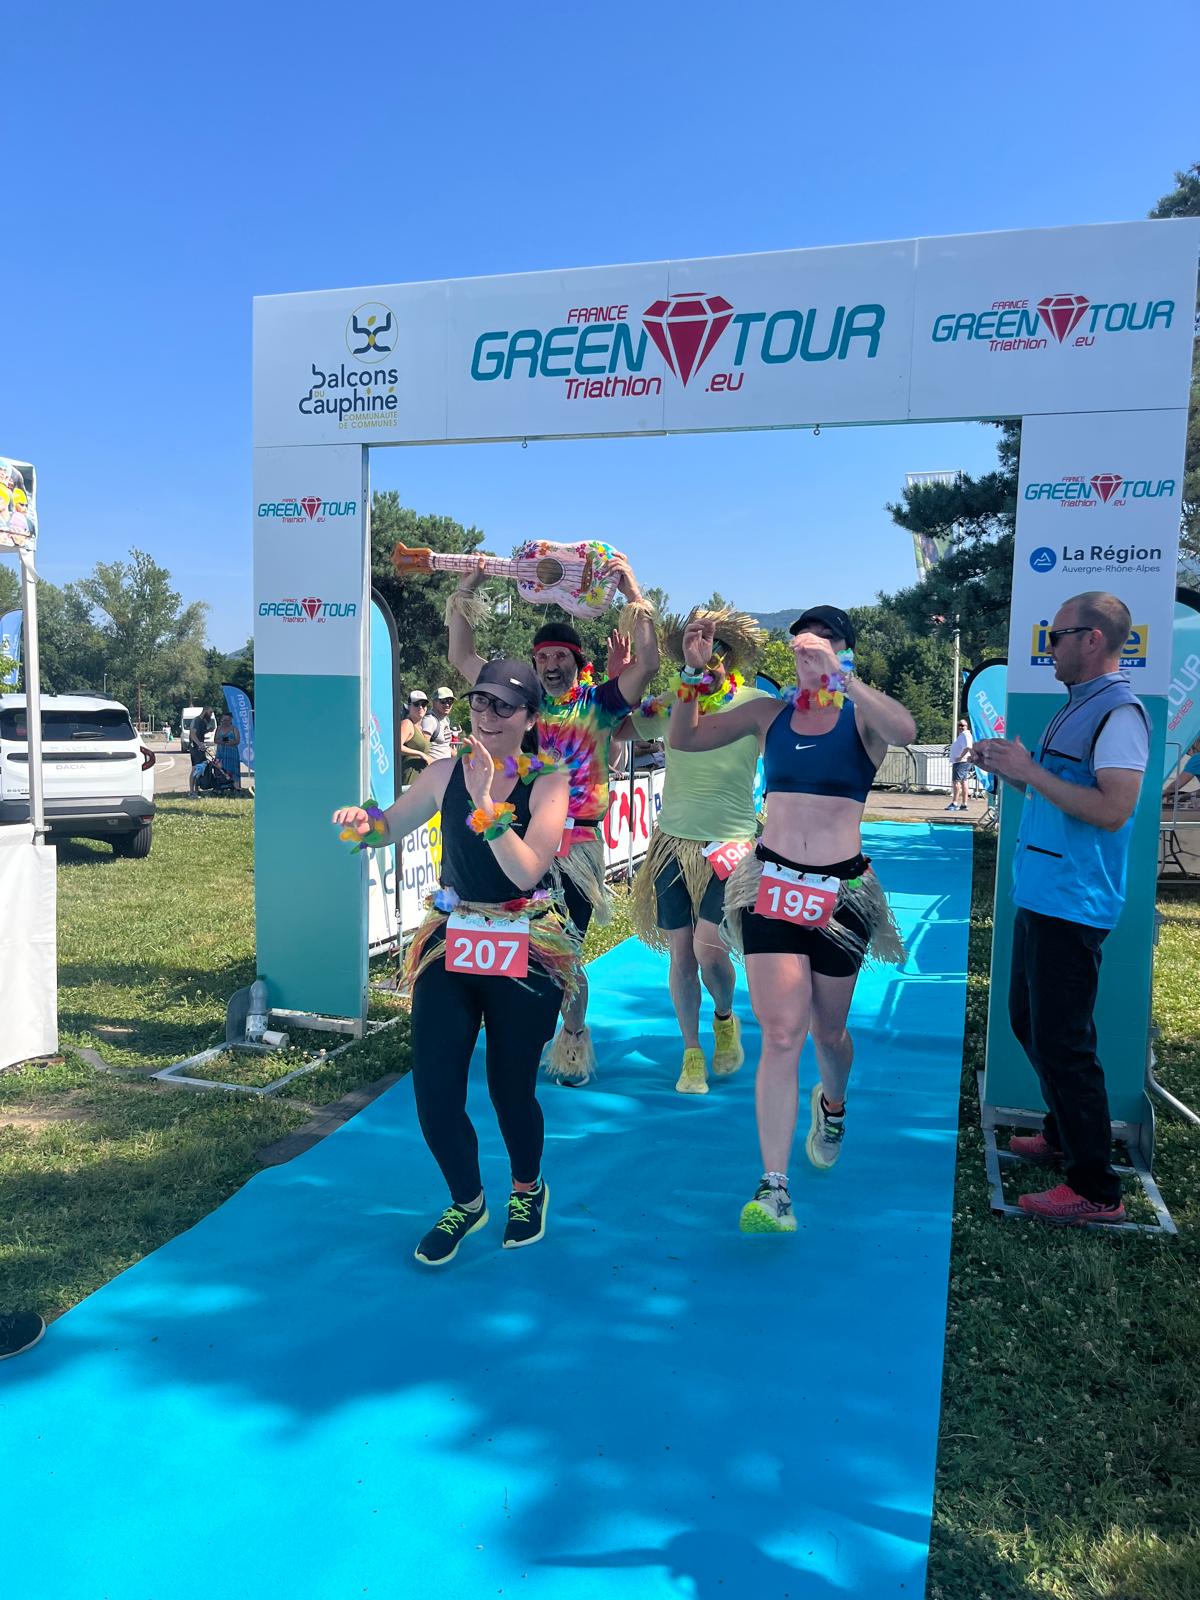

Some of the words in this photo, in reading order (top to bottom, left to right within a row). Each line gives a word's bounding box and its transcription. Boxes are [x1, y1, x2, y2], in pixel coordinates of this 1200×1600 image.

[567, 304, 629, 324] FRANCE
[992, 300, 1028, 310] FRANCE
[932, 310, 1040, 342] GREEN
[1089, 300, 1175, 333] TOUR
[470, 323, 648, 381] GREEN
[733, 304, 886, 366] TOUR
[989, 338, 1047, 352] Triathlon
[1072, 336, 1095, 348] .eu
[312, 363, 398, 389] balcons
[564, 375, 661, 400] Triathlon
[705, 372, 745, 393] .eu
[298, 386, 398, 422] dauphiné
[351, 420, 398, 429] COMMUNES
[1024, 482, 1092, 500] GREEN
[1123, 480, 1176, 498] TOUR
[258, 502, 302, 517] GREEN
[321, 502, 356, 516] TOUR
[1062, 546, 1084, 560] La
[1090, 544, 1162, 563] Région
[1062, 564, 1160, 574] Auvergne-Rhône-Alpes
[258, 602, 303, 616] GREEN
[322, 603, 356, 617] TOUR
[1168, 654, 1200, 716] OUR
[716, 842, 750, 872] 196
[768, 886, 824, 921] 195
[453, 938, 520, 970] 207
